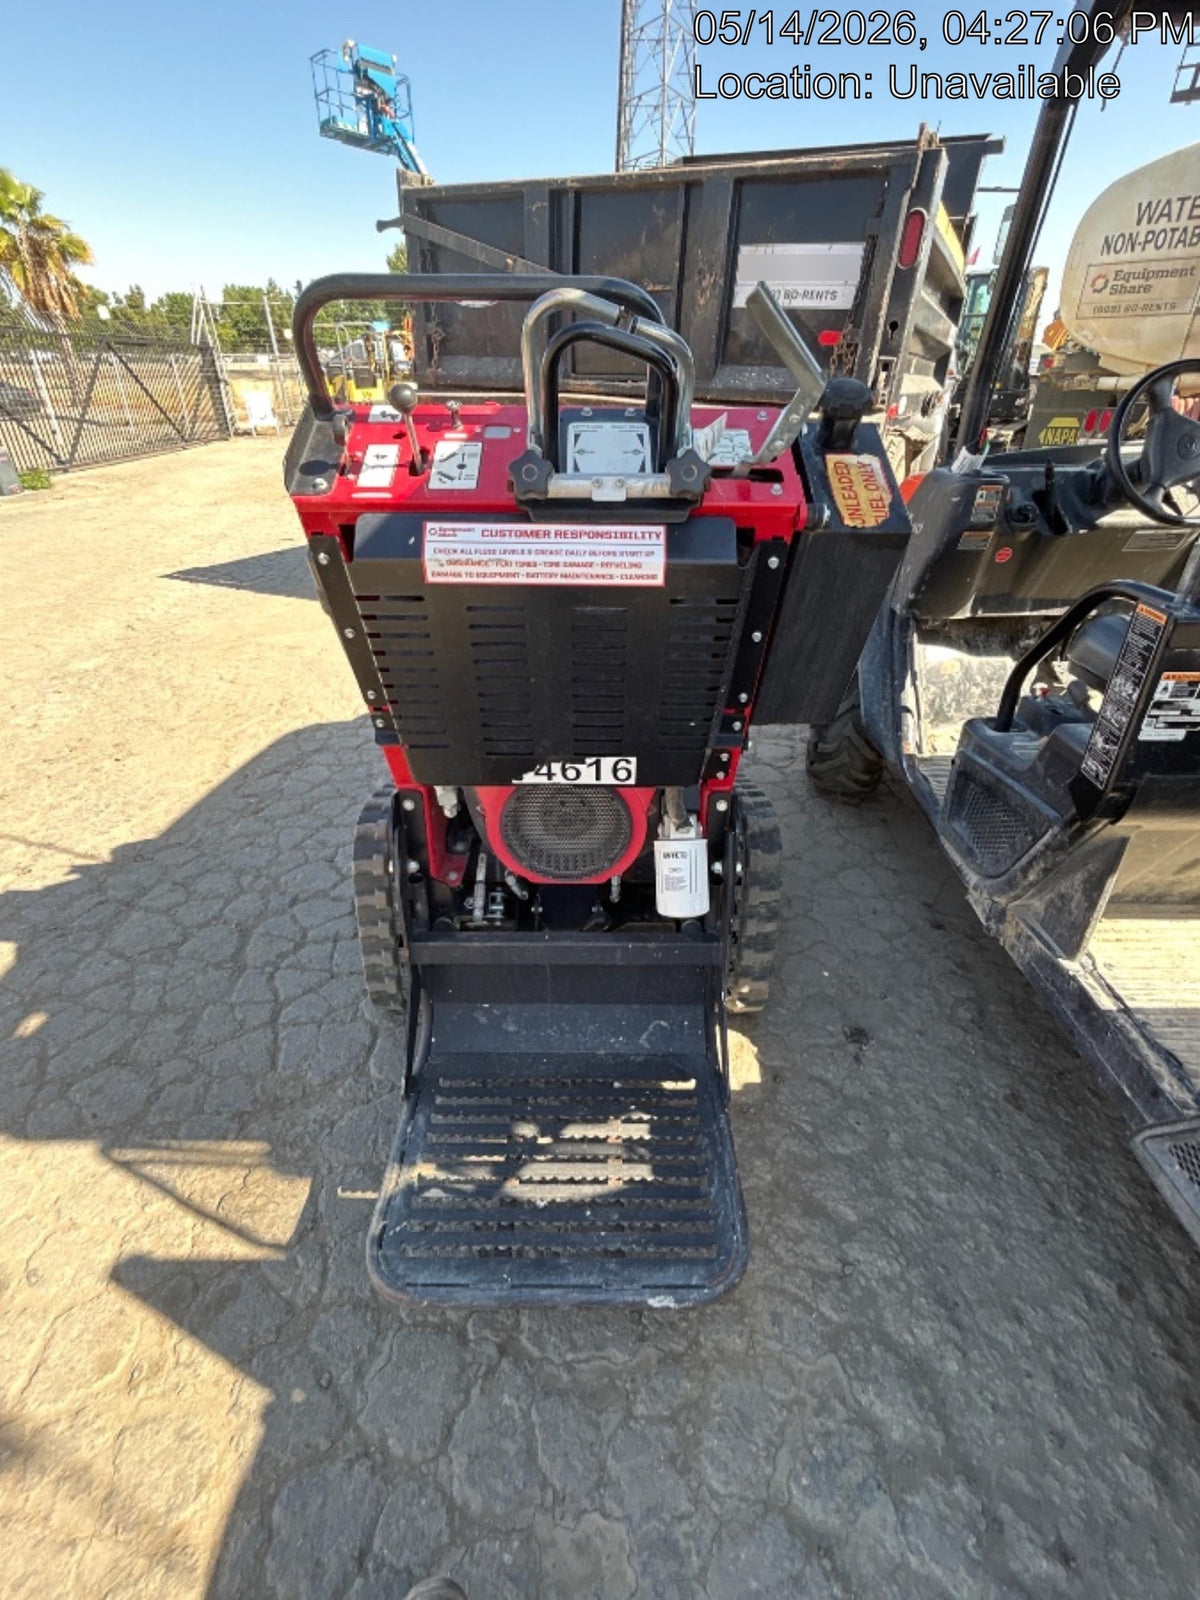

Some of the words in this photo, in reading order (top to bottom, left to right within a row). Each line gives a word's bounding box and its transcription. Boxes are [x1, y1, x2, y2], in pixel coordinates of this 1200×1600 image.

[1112, 266, 1196, 283] Equipment
[1109, 283, 1152, 296] Share
[1044, 428, 1077, 445] NAPA
[857, 461, 879, 491] ONLY
[481, 528, 551, 539] CUSTOMER
[554, 529, 662, 540] RESPONSIBILITY
